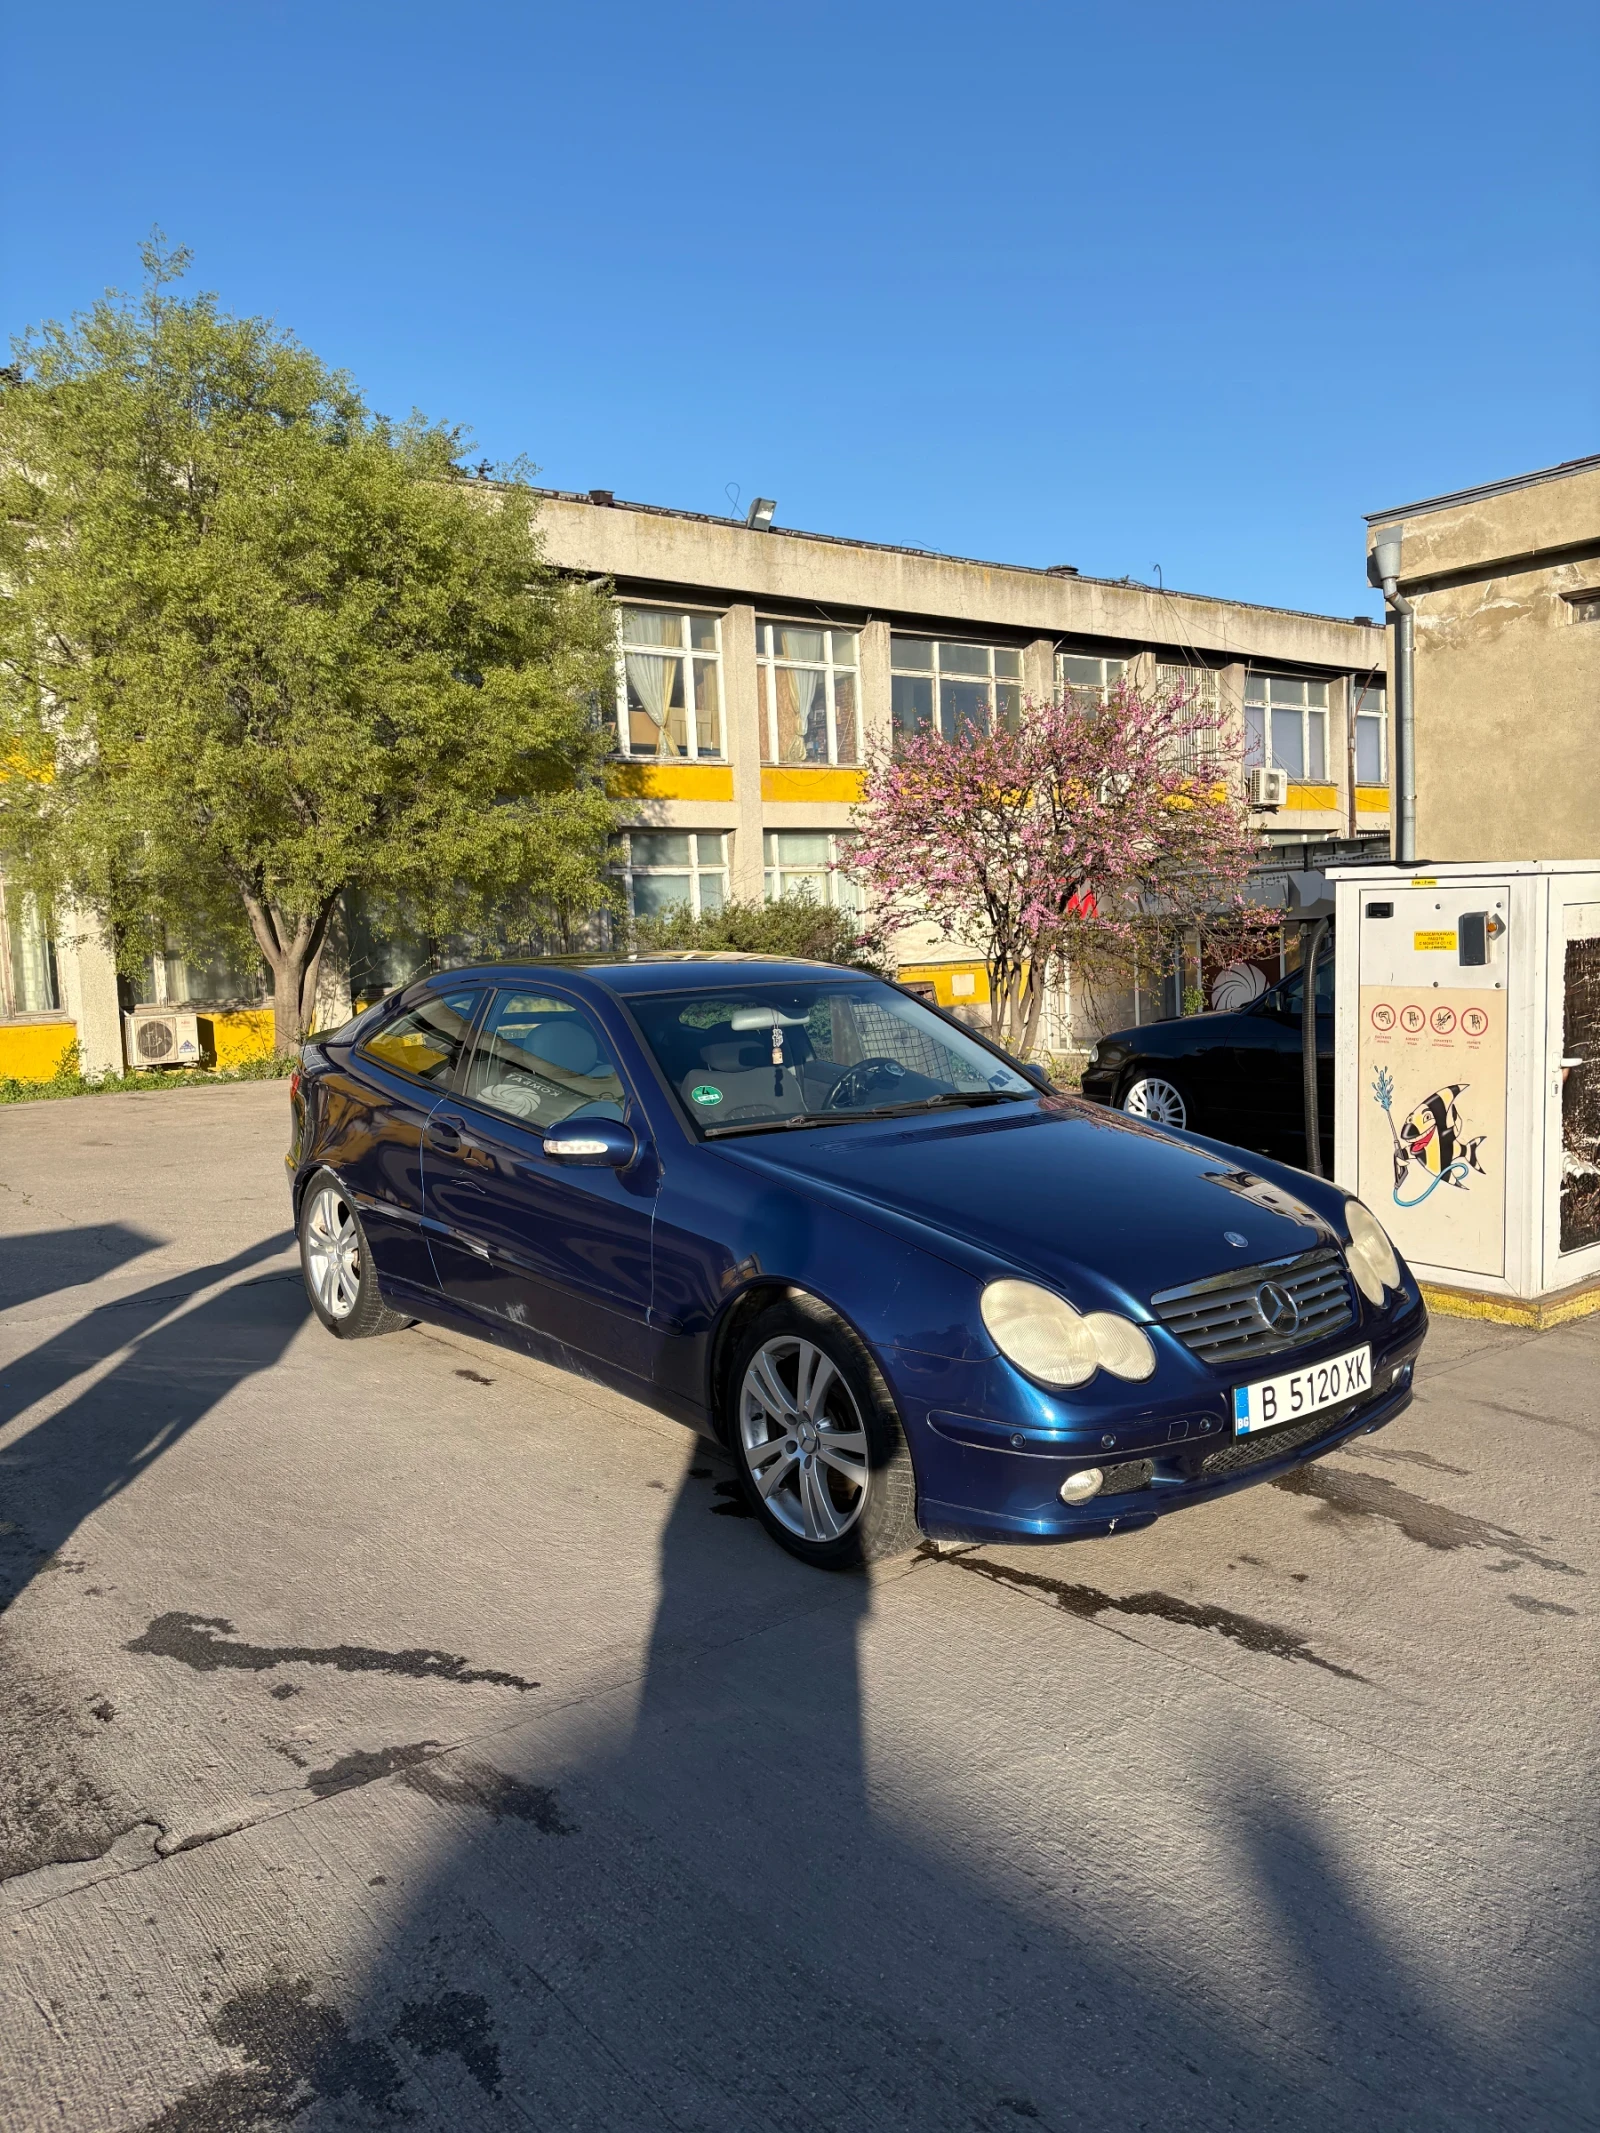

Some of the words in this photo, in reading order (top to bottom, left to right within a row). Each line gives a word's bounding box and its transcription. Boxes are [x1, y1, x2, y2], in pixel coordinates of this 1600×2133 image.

[702, 1086, 710, 1095] 4
[1262, 1385, 1278, 1422] B
[1290, 1364, 1341, 1412] 5120
[1344, 1352, 1367, 1393] XK
[1237, 1416, 1249, 1430] BG
